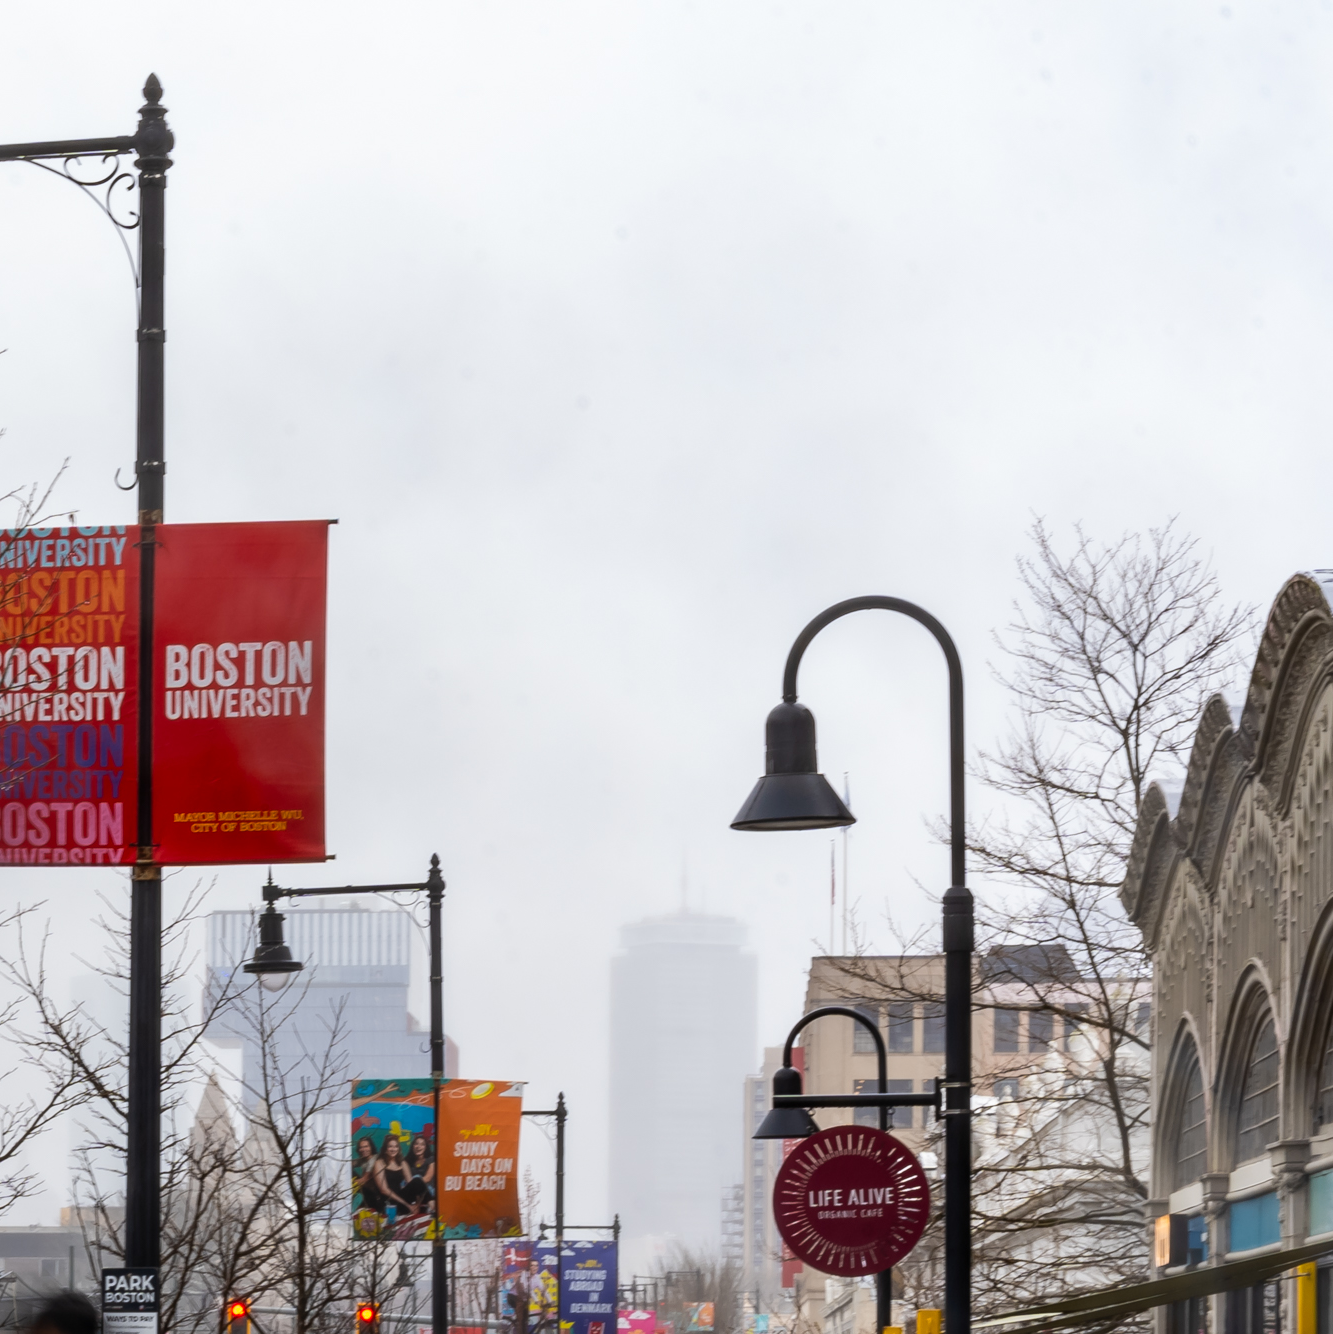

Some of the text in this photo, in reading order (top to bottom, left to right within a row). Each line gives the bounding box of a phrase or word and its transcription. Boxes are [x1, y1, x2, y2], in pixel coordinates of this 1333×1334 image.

[165, 641, 313, 688] BOSTON
[164, 686, 313, 720] UNIVERSITY
[173, 812, 216, 823] MAYOR
[218, 810, 279, 821] MICHELLE
[190, 821, 287, 833] CITY OF BOSTON
[453, 1141, 499, 1157] SUNNY
[460, 1158, 514, 1174] DAYS ON
[444, 1175, 507, 1191] BU BEACH
[808, 1186, 895, 1208] LIFE ALIVE
[817, 1208, 884, 1219] ORGANIC CAFE
[104, 1274, 155, 1291] PARK
[104, 1291, 156, 1304] BOSTON
